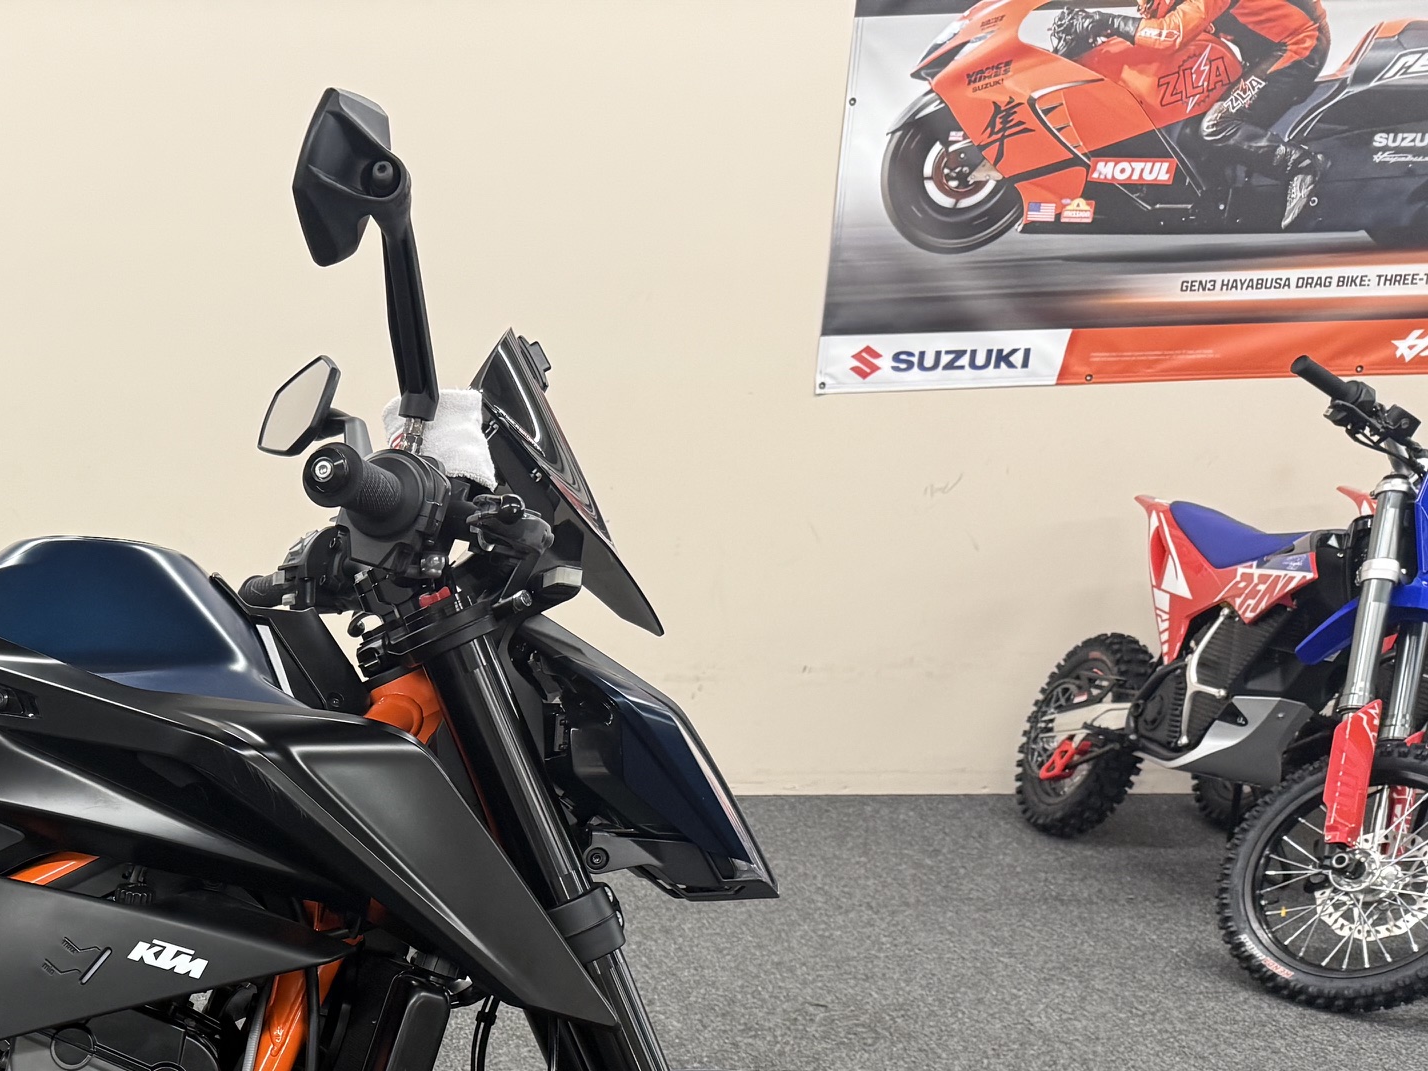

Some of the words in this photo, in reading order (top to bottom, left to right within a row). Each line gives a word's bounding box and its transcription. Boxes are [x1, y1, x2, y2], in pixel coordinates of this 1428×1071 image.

[972, 78, 1004, 93] SUZUKI
[1158, 57, 1231, 107] ZLA
[1092, 161, 1170, 181] MOTUL
[1180, 279, 1216, 292] GEN3
[1220, 277, 1291, 291] HAYABUSA
[1295, 276, 1333, 289] DRAG
[1336, 275, 1371, 287] BIKE:
[890, 348, 1031, 373] SUZUKI
[127, 938, 209, 980] KTM
